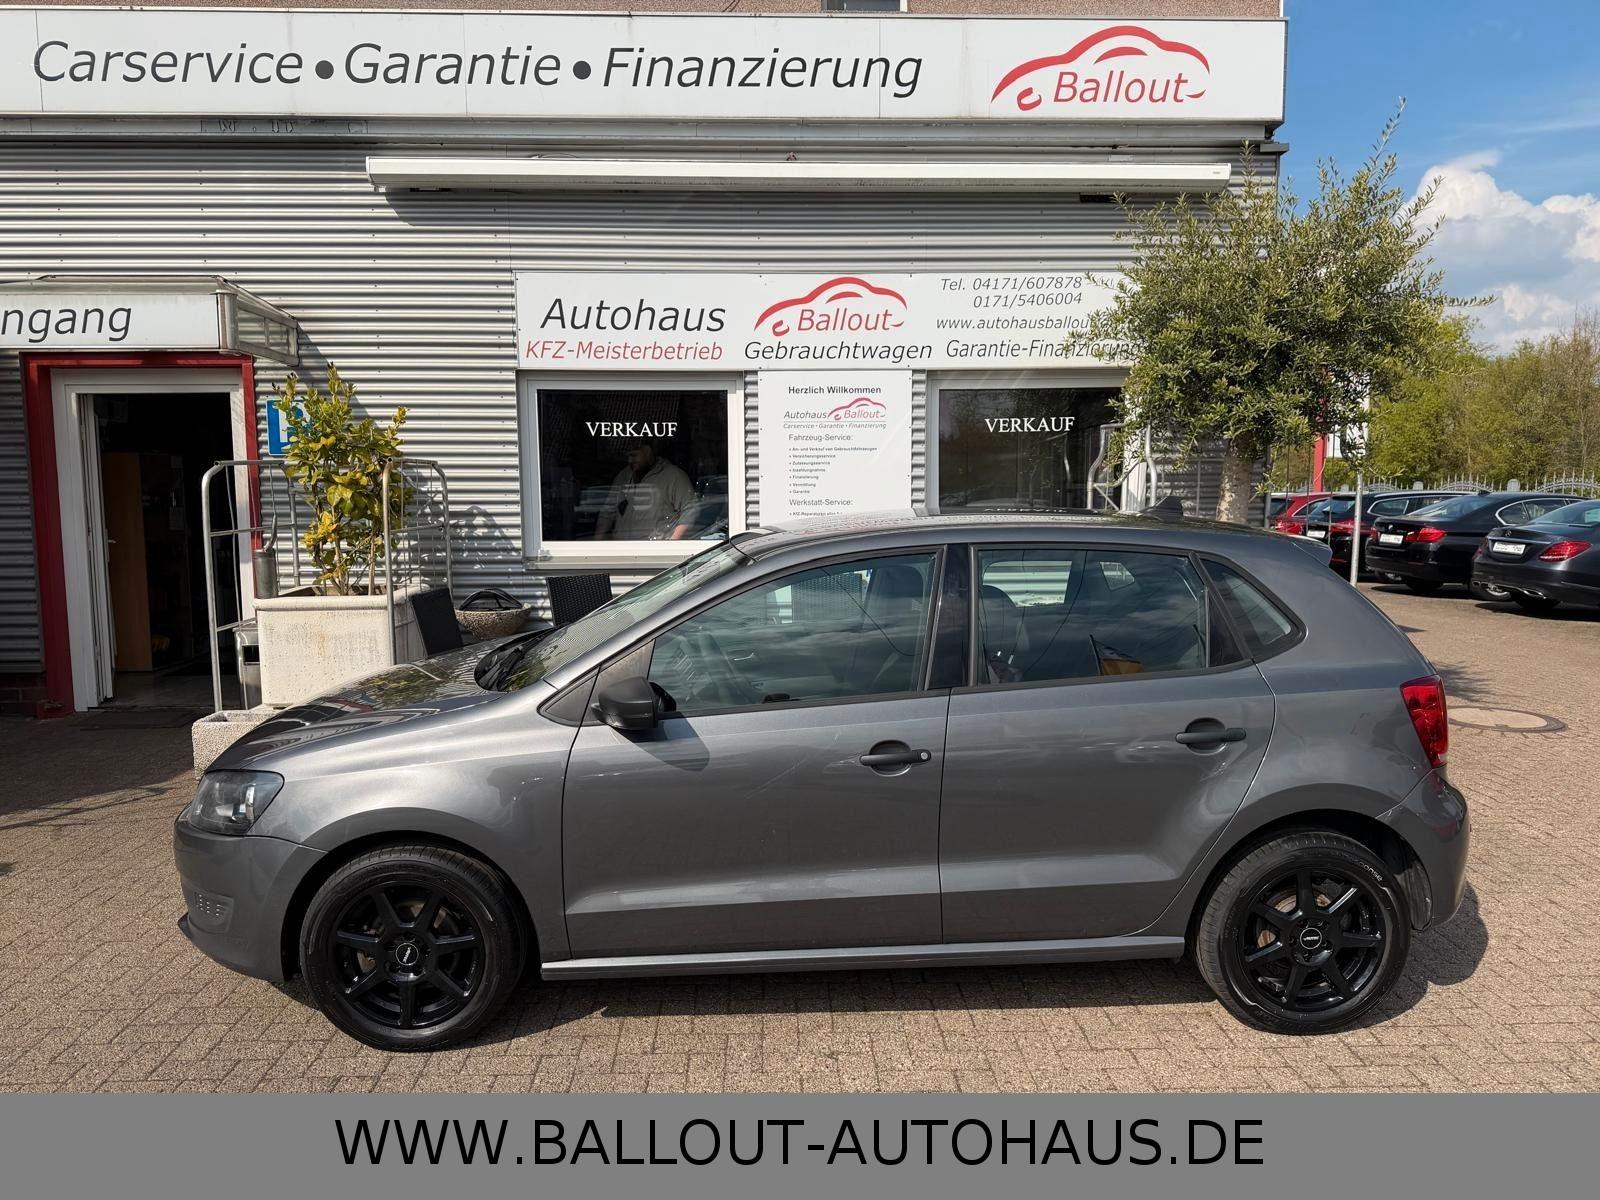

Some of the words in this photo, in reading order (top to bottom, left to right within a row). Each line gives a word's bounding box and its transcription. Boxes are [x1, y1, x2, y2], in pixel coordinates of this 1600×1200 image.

[33, 41, 303, 83] Carservice
[345, 43, 561, 85] Garantie
[603, 48, 923, 99] Finanzierung
[1053, 70, 1188, 103] Ballout
[941, 278, 965, 291] Tel.
[973, 276, 1082, 292] 04171/607878
[973, 292, 1082, 309] 0171/5406004
[540, 298, 726, 332] Autohaus
[797, 307, 893, 332] Ballout
[936, 312, 1091, 333] www.autohausballou
[525, 340, 723, 361] KFZ-Meisterbetrieb
[744, 340, 932, 364] Gebrauchtwagen
[788, 386, 825, 394] Herzlich
[827, 386, 882, 394] Willkommen
[783, 410, 827, 419] Autohaus
[843, 409, 880, 419] Ballout
[586, 421, 678, 437] VERKAUF
[848, 422, 887, 430] Finanzierung
[985, 417, 1075, 434] VERKAUF
[788, 434, 854, 442] Fahrzeug-Service:
[789, 498, 854, 506] Werkstatt-Service:
